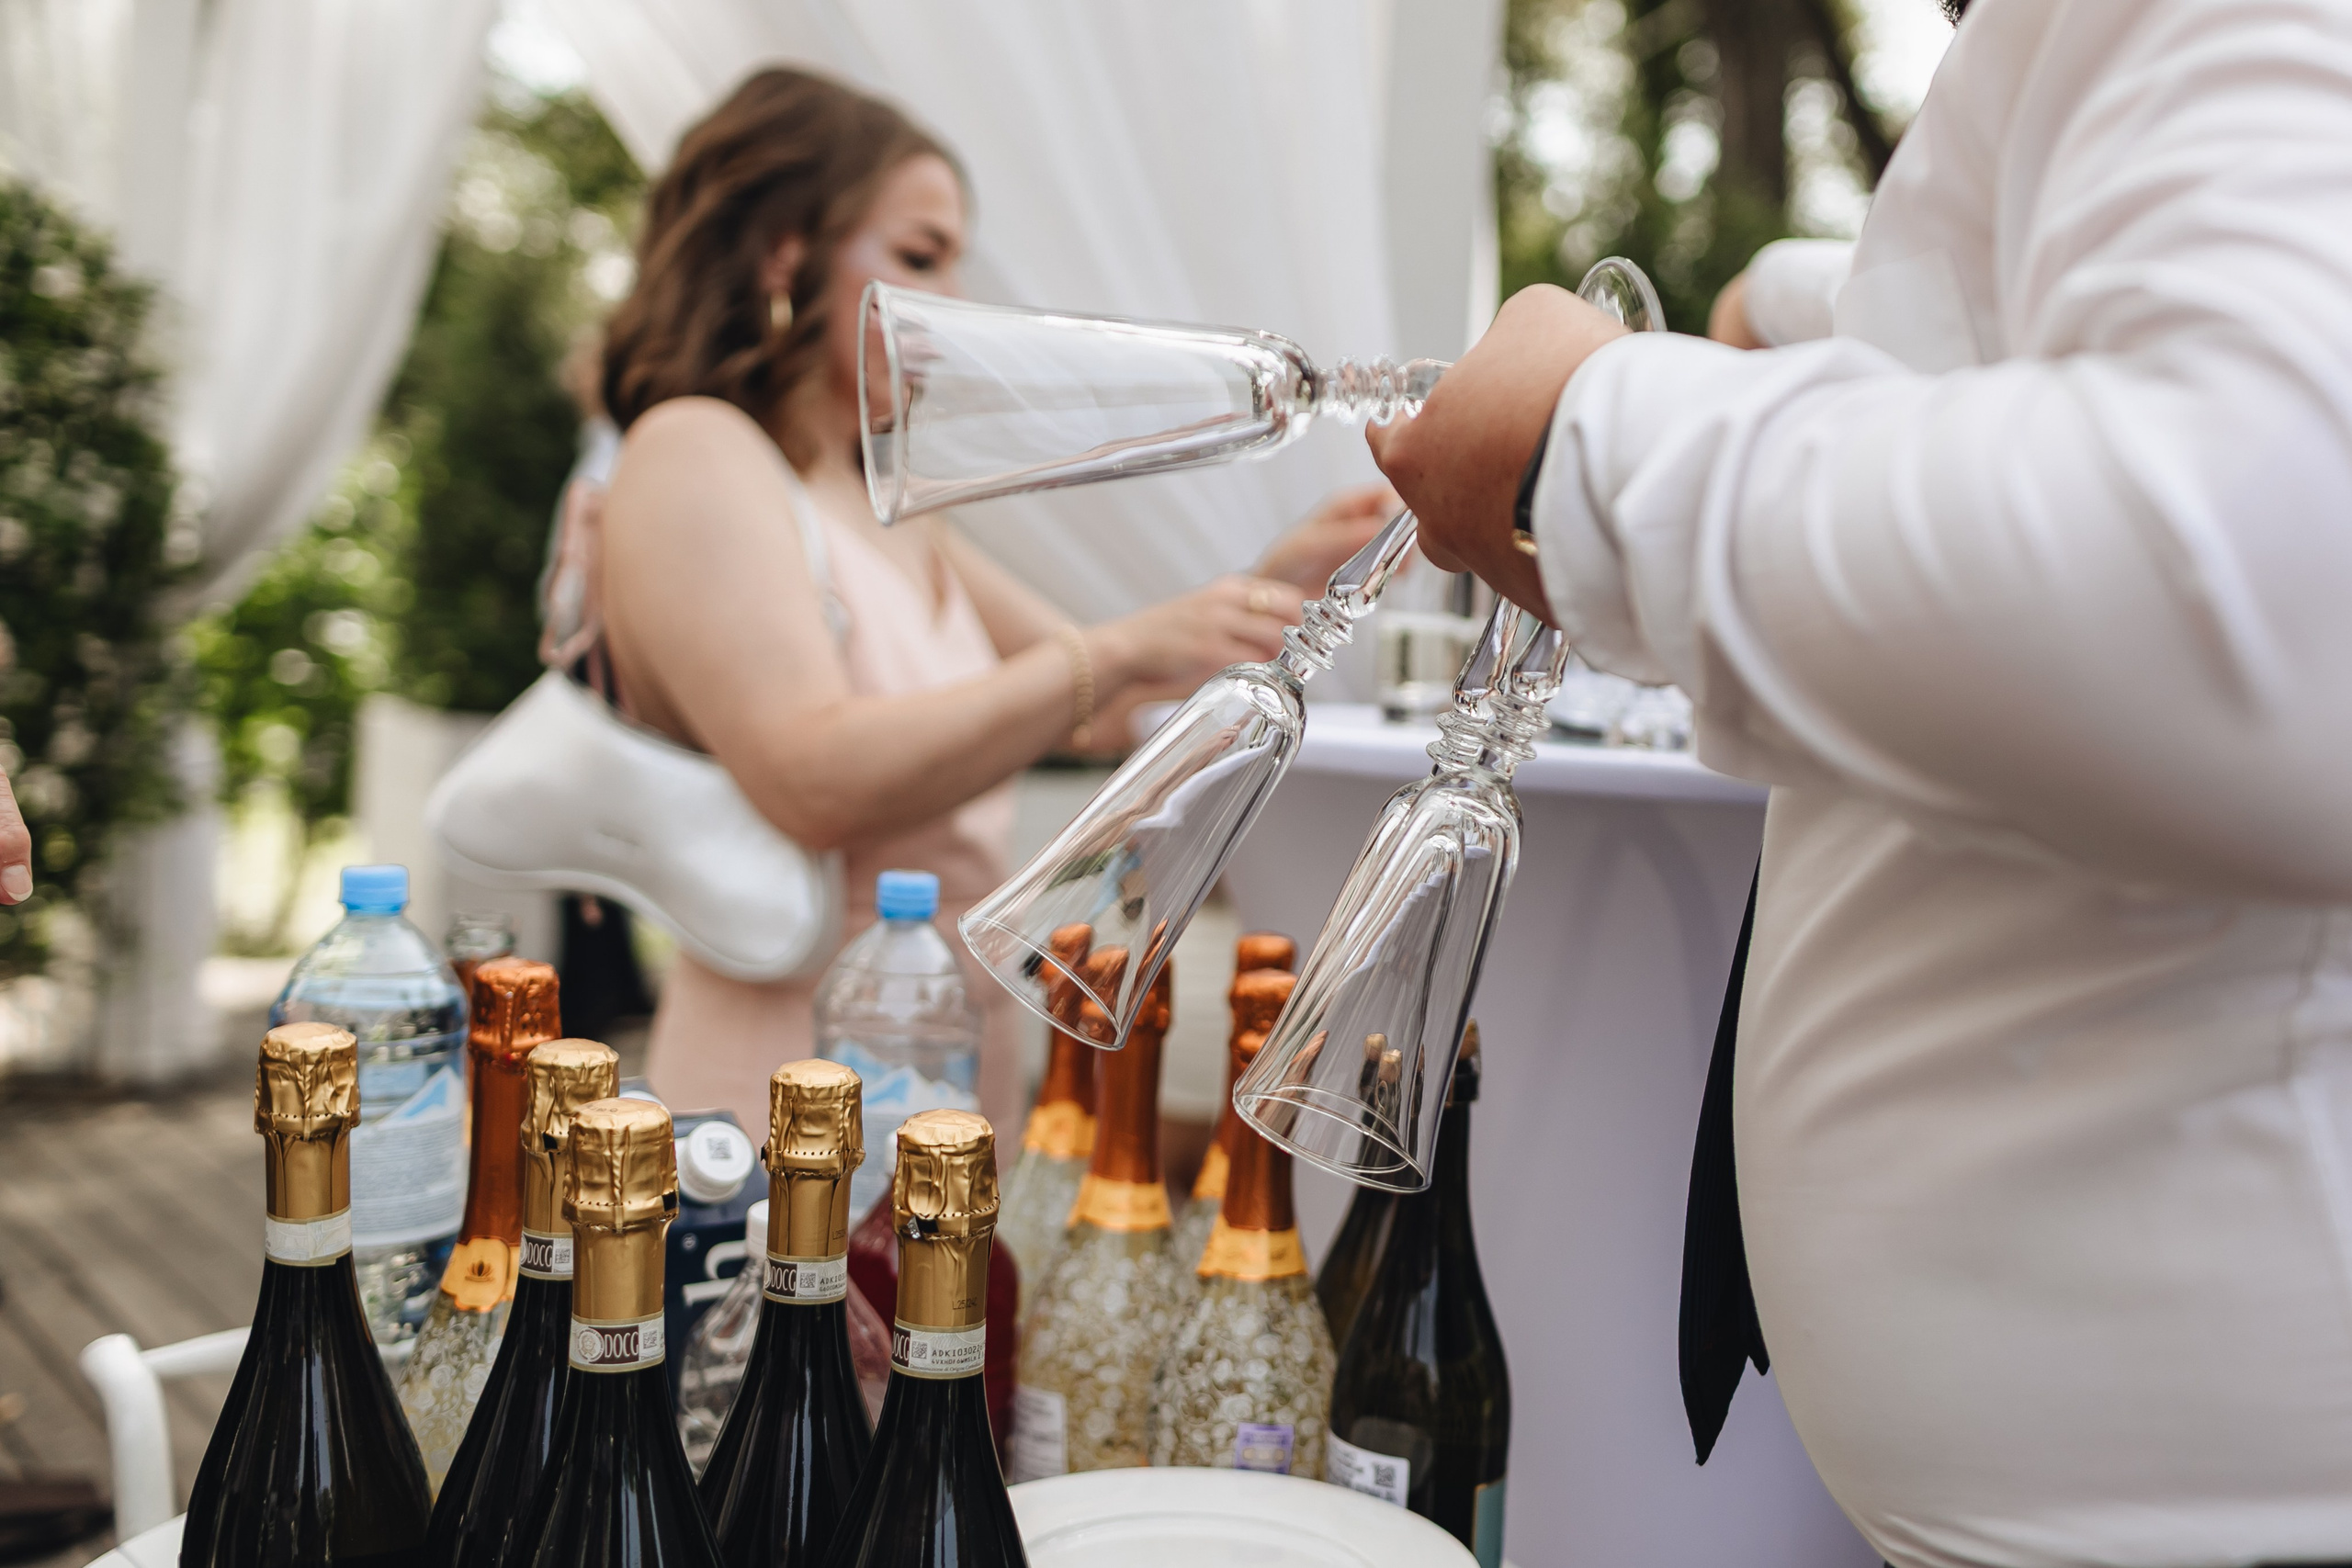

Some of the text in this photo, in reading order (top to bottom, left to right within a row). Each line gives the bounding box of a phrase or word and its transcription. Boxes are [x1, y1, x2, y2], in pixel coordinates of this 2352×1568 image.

[527, 1242, 553, 1268] DOCG
[772, 1266, 797, 1292] DOCG
[604, 1331, 639, 1359] DOCG
